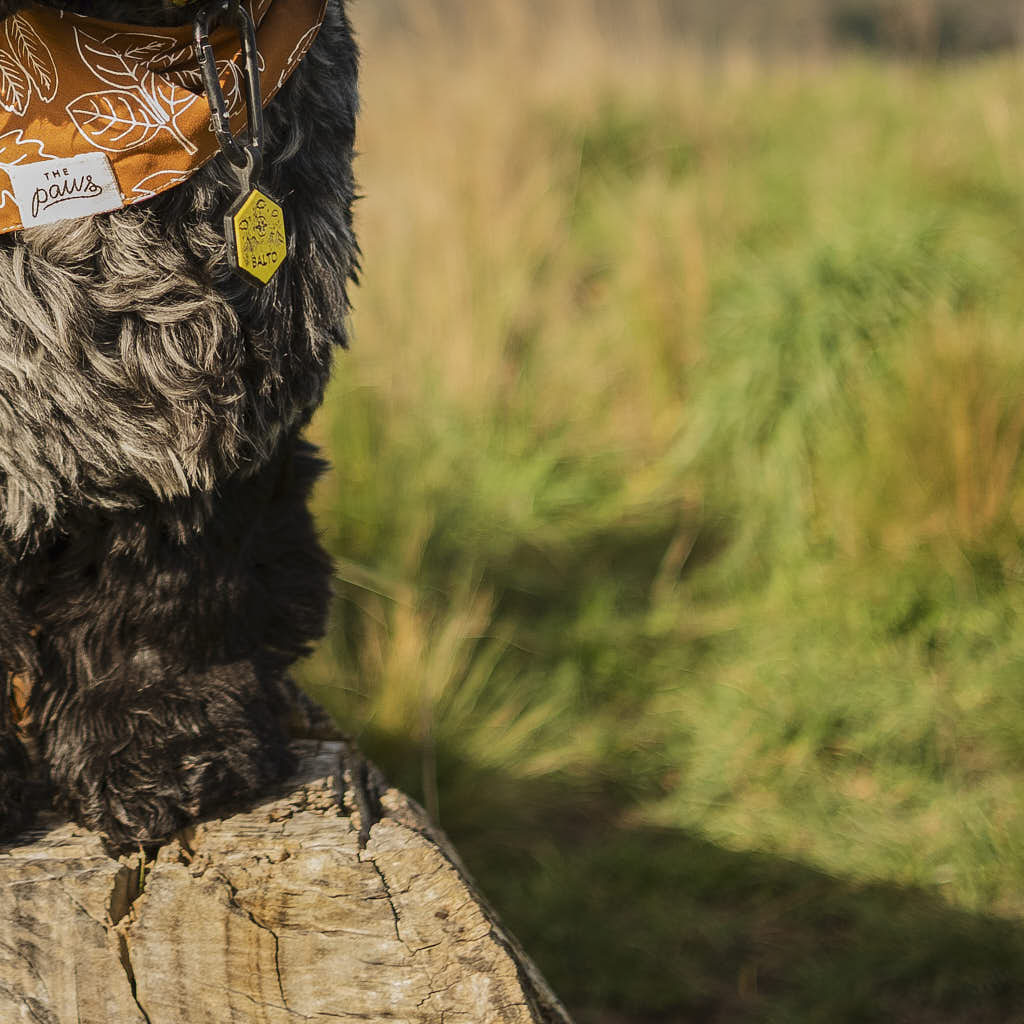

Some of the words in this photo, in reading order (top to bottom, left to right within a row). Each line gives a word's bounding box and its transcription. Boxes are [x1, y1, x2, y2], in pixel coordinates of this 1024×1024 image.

[44, 168, 70, 181] THE
[32, 175, 103, 218] paws
[252, 251, 278, 269] BALTO
